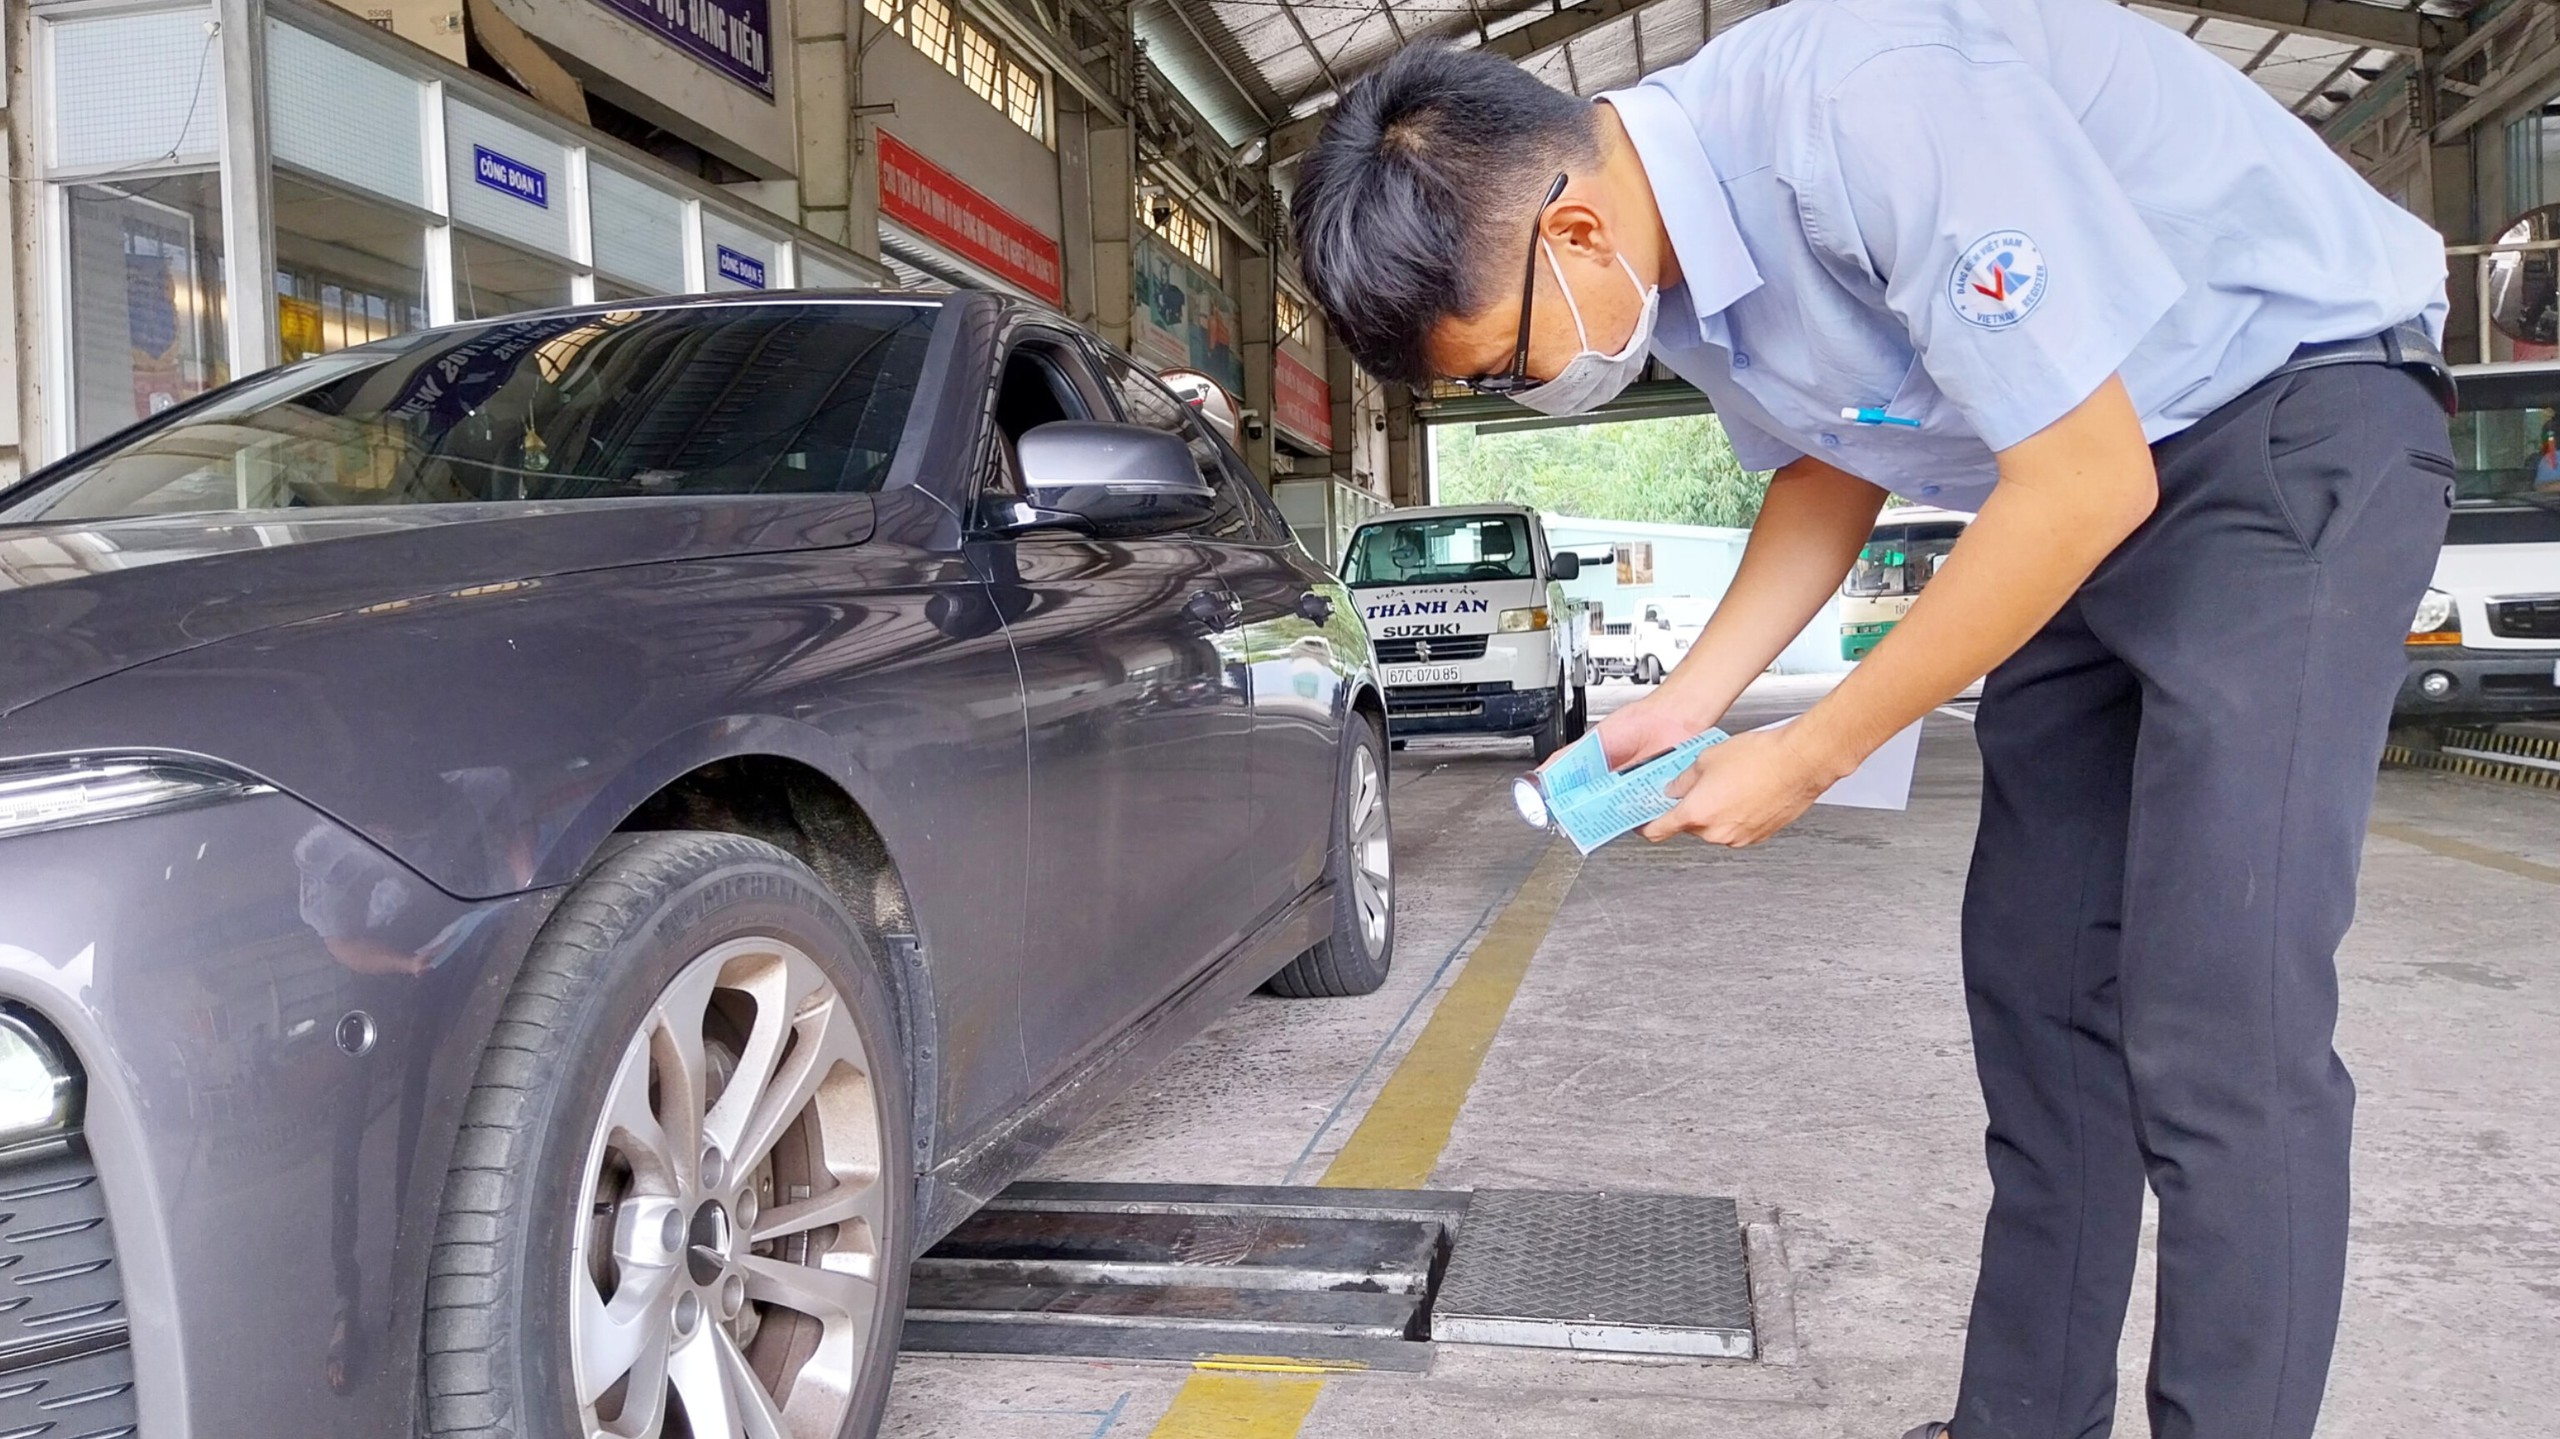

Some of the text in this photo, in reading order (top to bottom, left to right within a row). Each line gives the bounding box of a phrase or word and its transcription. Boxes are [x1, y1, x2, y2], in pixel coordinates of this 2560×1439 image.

[480, 155, 543, 198] CÔNG ĐOẠN 1
[721, 252, 739, 274] CÔNG
[1366, 600, 1489, 619] THÀNH AN
[1383, 623, 1461, 638] SUZUKI
